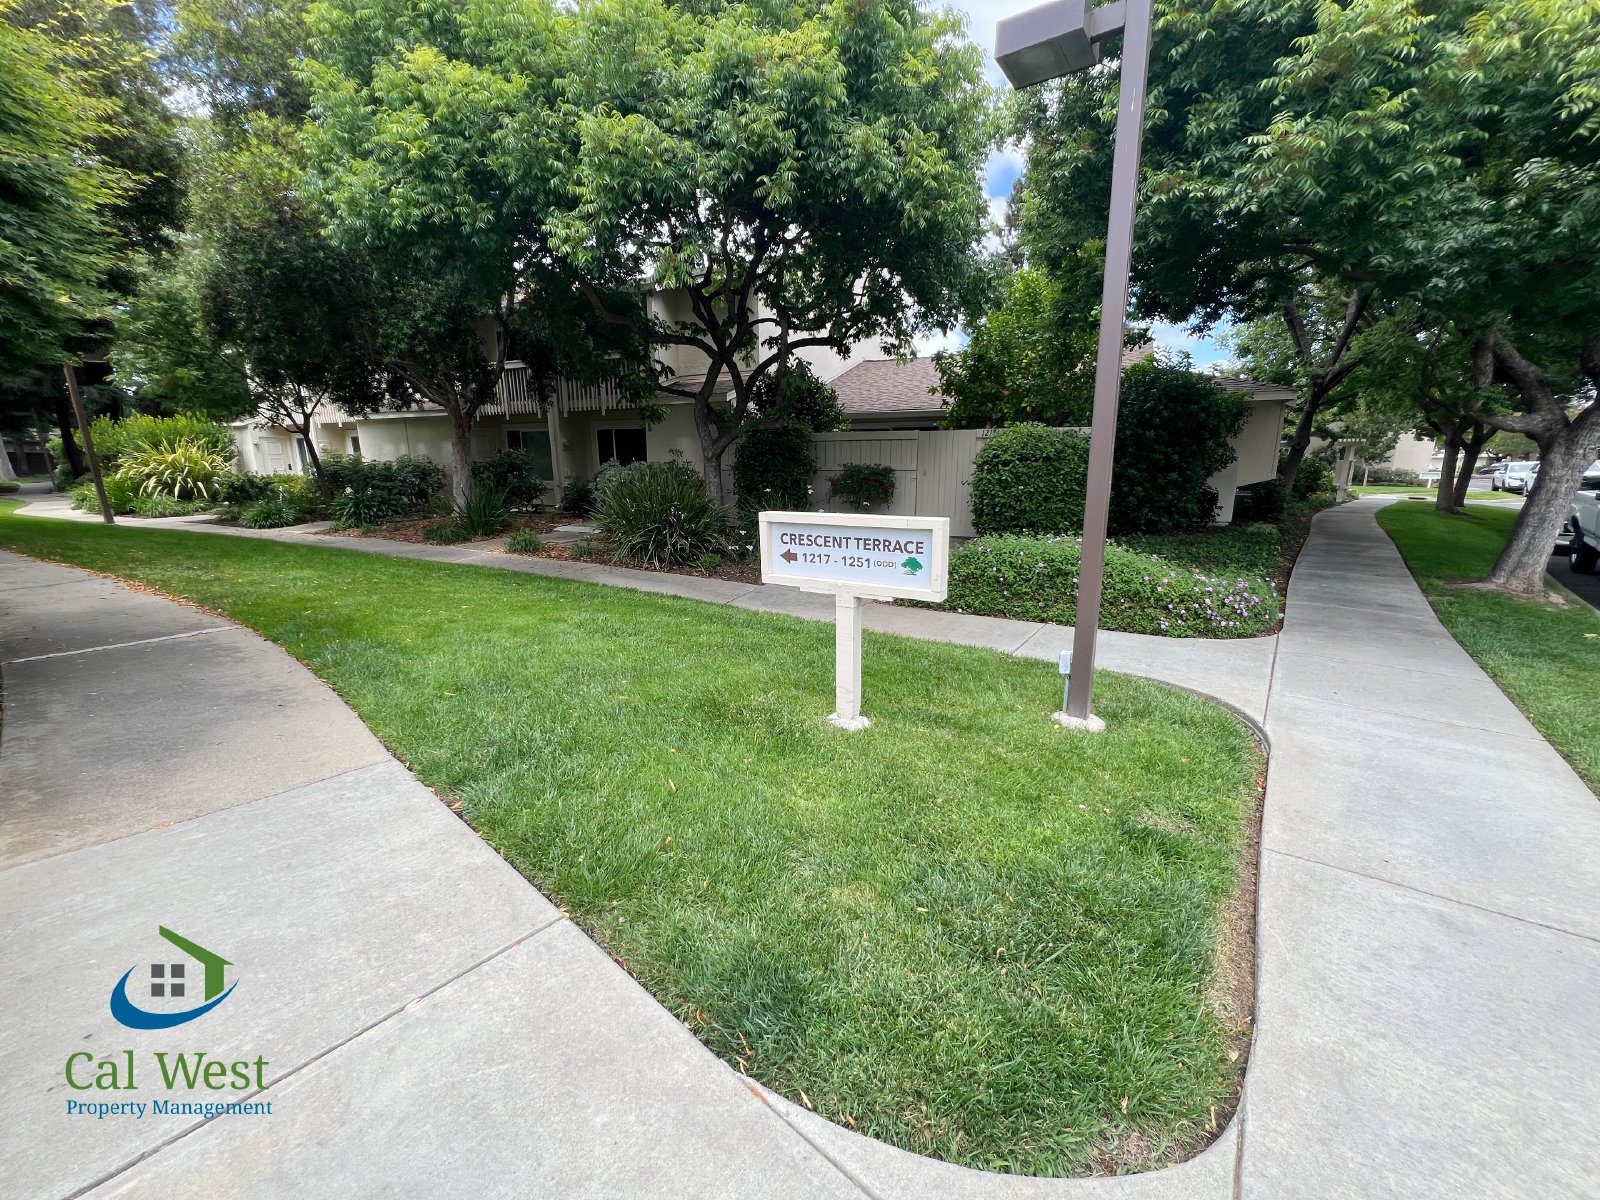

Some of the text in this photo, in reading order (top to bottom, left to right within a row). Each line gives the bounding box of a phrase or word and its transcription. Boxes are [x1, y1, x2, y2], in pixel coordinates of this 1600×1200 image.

[780, 532, 924, 555] CRESCENT TERRACE
[802, 552, 831, 565] 1217
[841, 555, 871, 569] 1251
[873, 559, 897, 569] (ODD)
